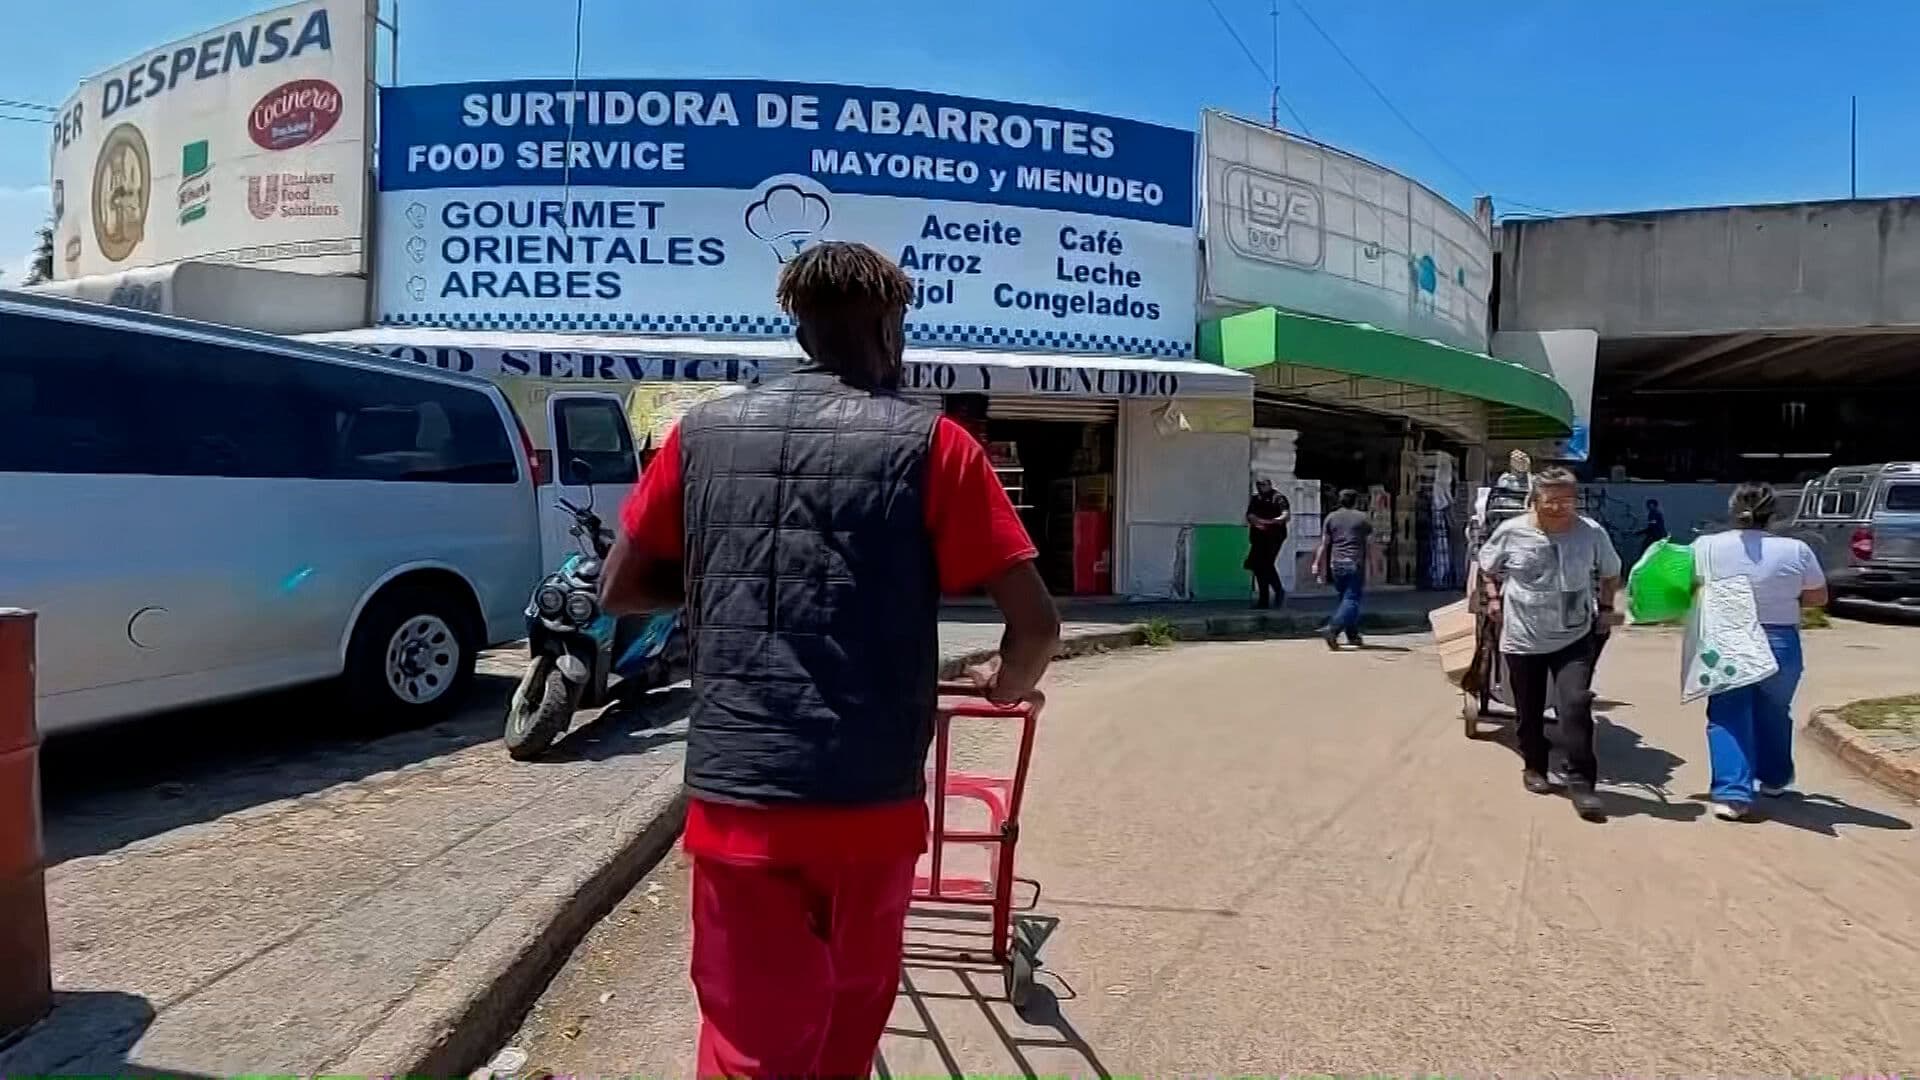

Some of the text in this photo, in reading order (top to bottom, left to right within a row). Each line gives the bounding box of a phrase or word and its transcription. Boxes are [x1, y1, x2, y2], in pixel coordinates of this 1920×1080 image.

[102, 9, 331, 119] DESPENSA
[255, 86, 338, 130] Cocineros
[462, 91, 1115, 159] SURTIDORA DE ABARROTES
[408, 141, 686, 172] FOOD SERVICE
[811, 148, 1164, 207] MAYOREO y MENUDEO
[442, 200, 666, 230] GOURMET
[921, 215, 1022, 246] Aceite
[442, 235, 726, 267] ORIENTALES
[1059, 225, 1123, 257] Café
[900, 245, 982, 275] Arroz
[1057, 256, 1142, 289] Leche
[440, 270, 623, 301] ARABES
[993, 281, 1161, 321] Congelados
[501, 349, 762, 384] SERVICE
[1026, 365, 1180, 397] MENUDEO
